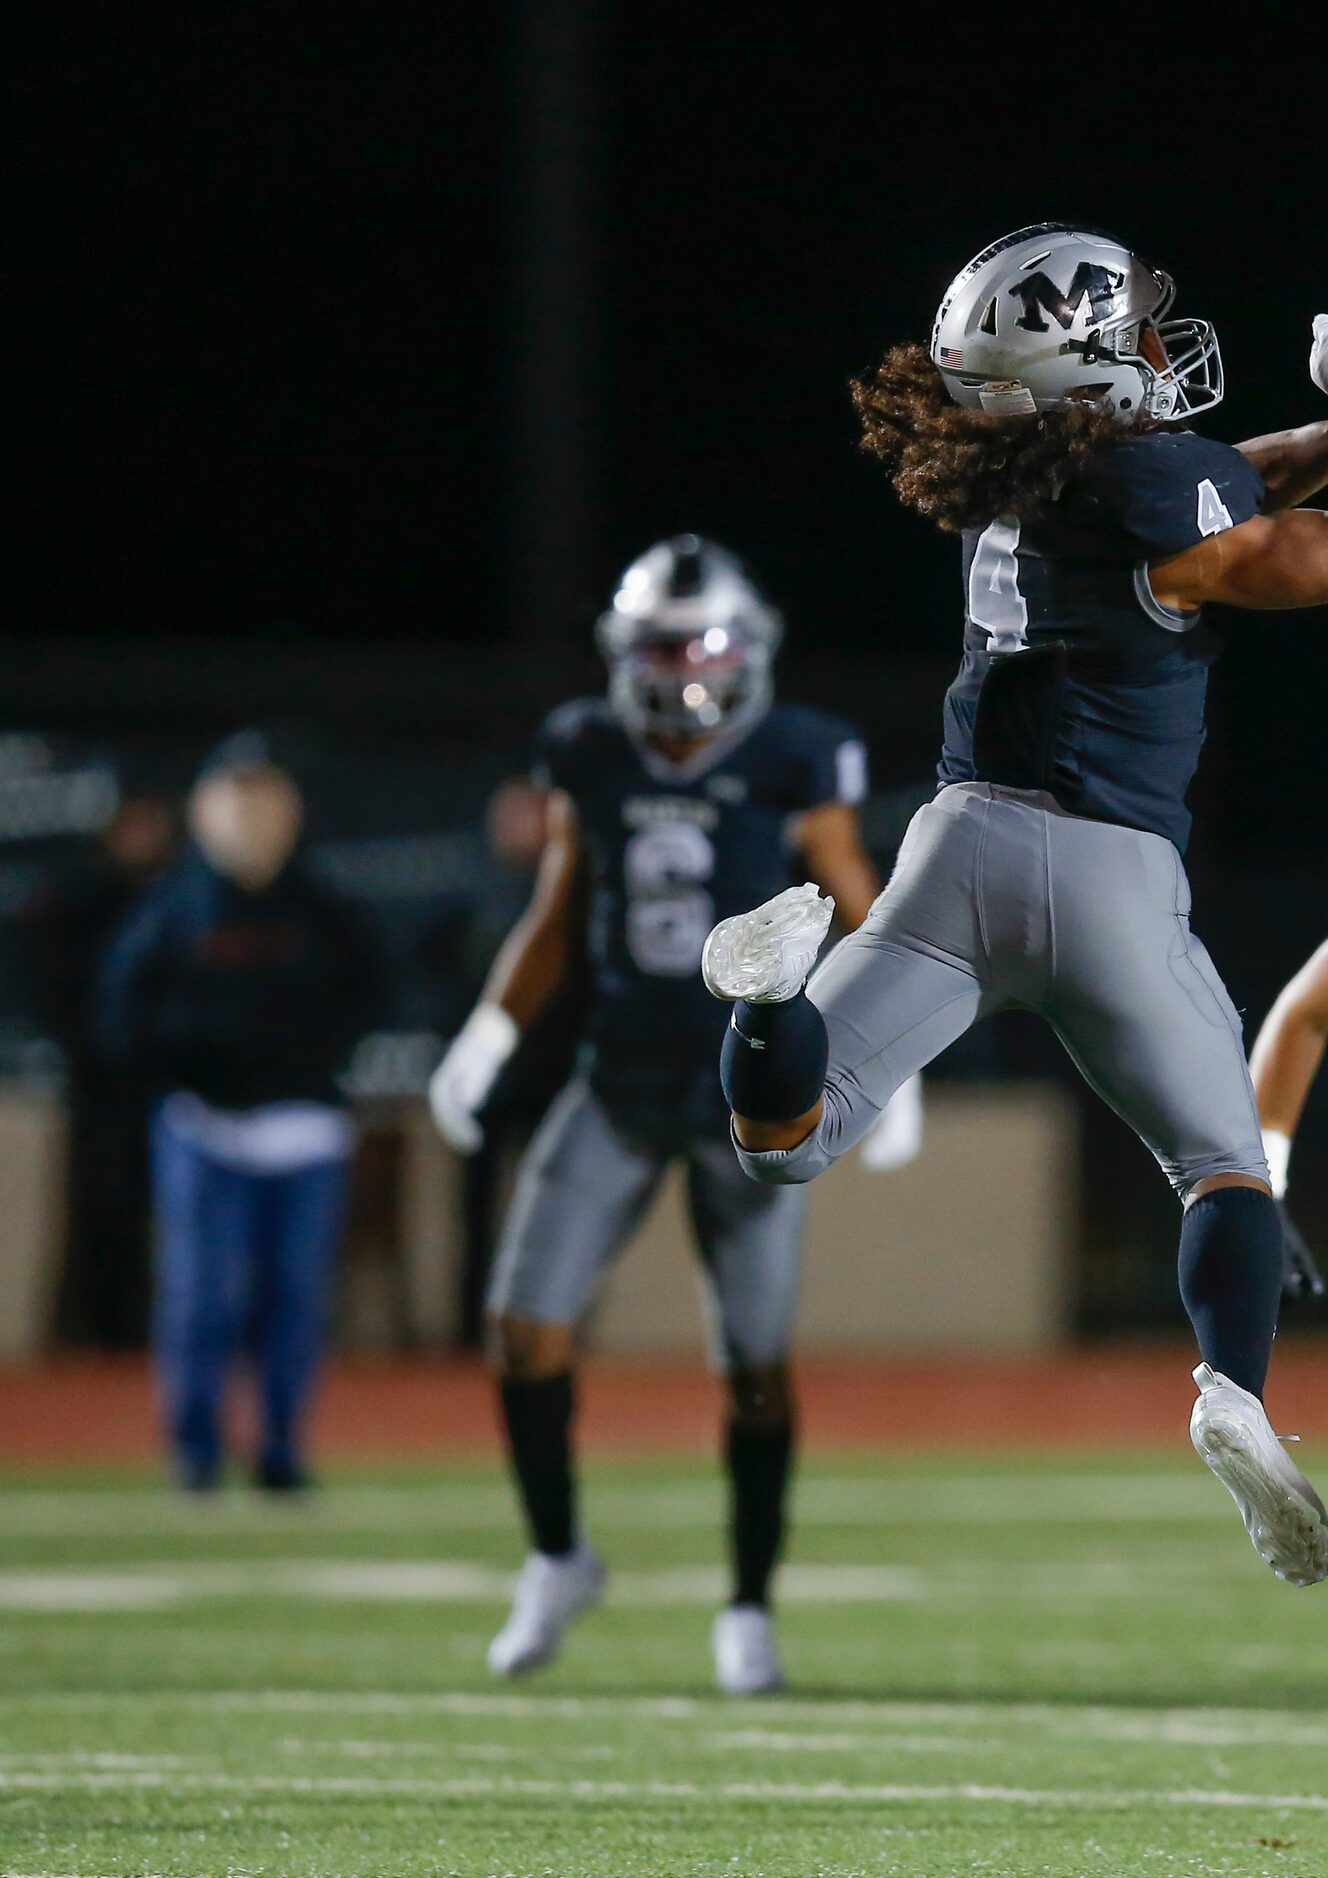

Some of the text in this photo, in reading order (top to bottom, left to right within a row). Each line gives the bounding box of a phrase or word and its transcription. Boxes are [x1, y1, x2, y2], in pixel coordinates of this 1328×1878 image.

[1008, 261, 1124, 333] M
[1195, 477, 1234, 539] 4
[968, 514, 1030, 652] 4
[624, 820, 716, 978] 6
